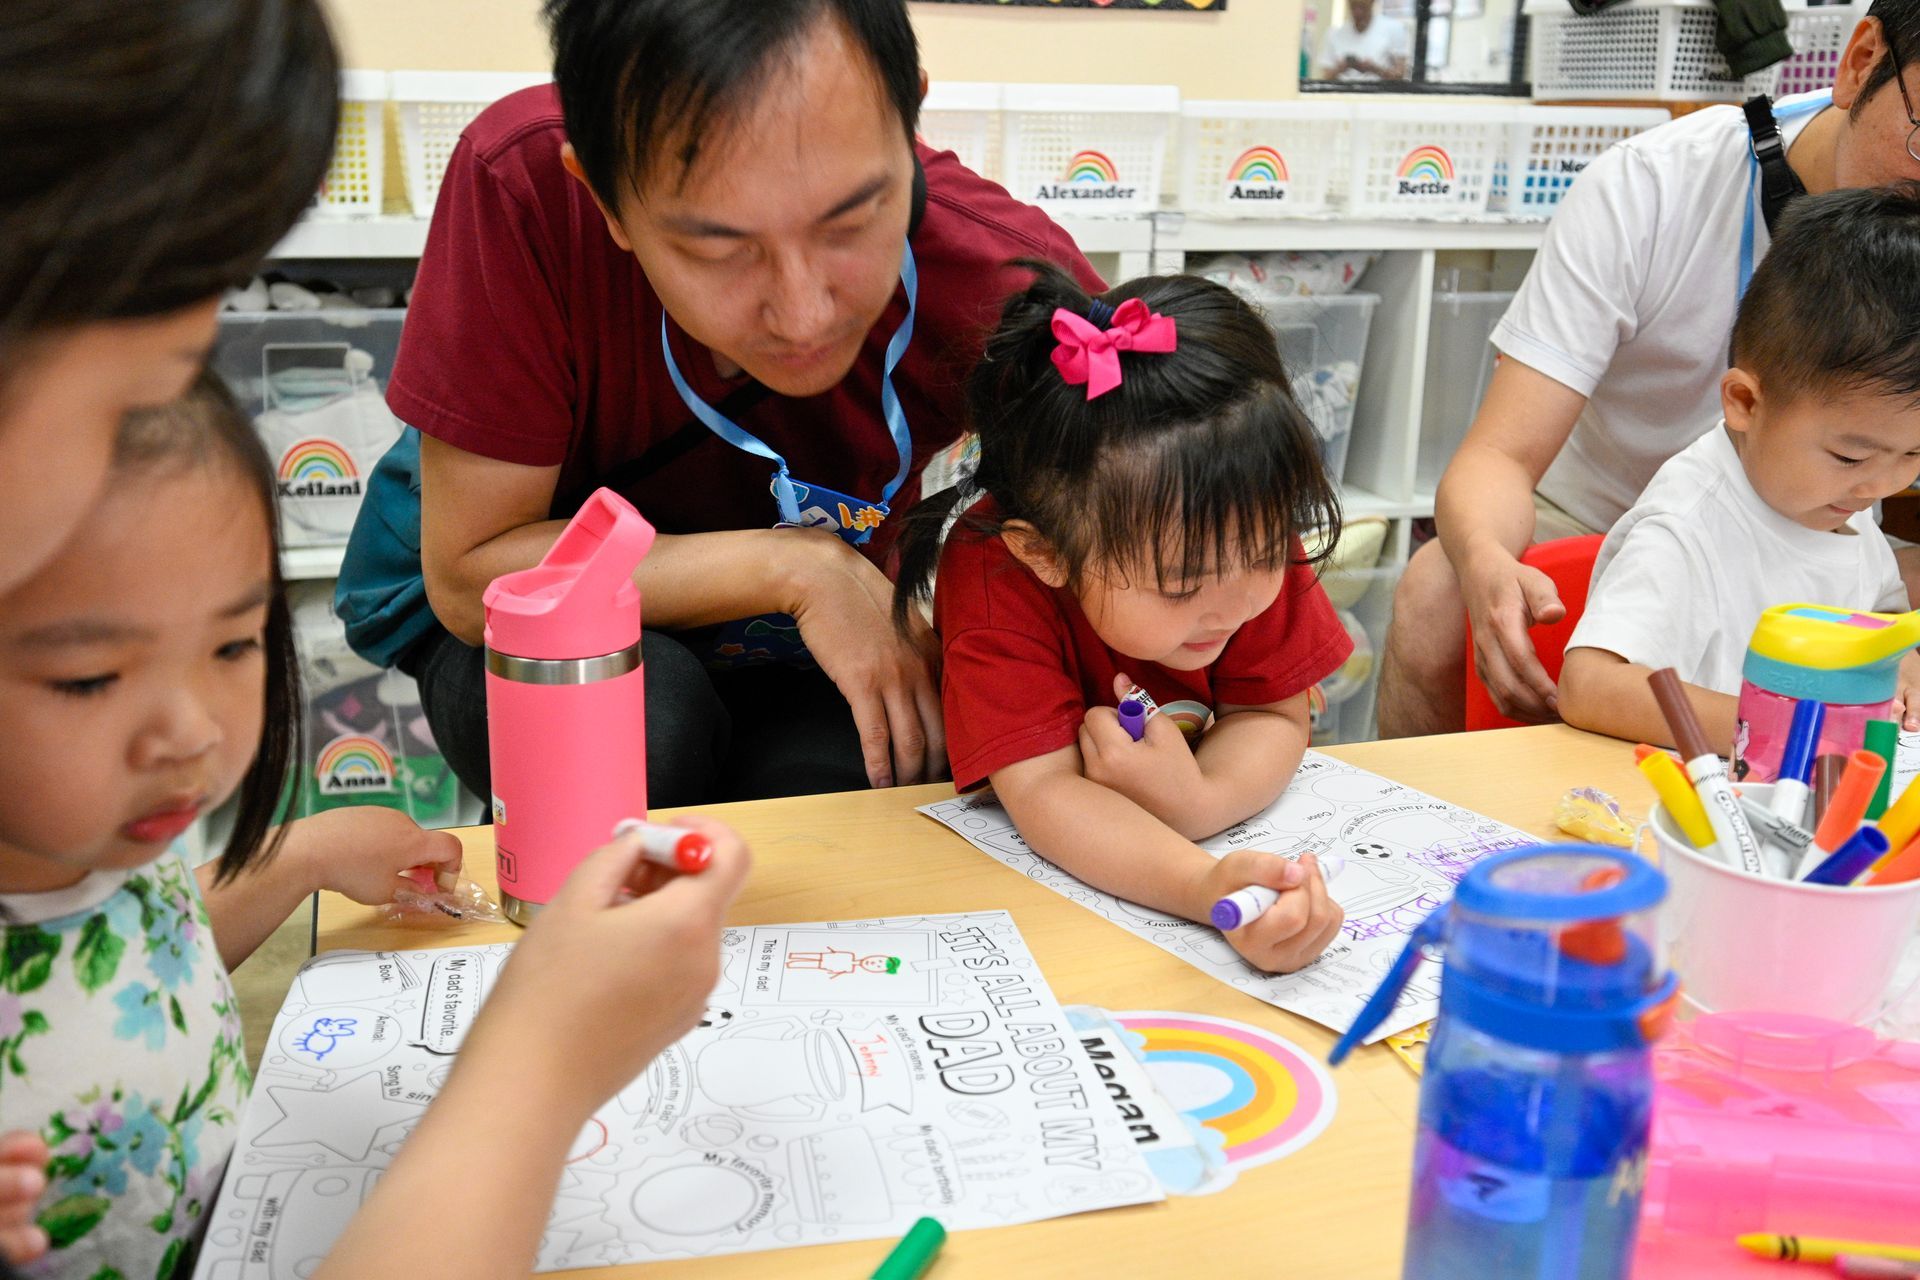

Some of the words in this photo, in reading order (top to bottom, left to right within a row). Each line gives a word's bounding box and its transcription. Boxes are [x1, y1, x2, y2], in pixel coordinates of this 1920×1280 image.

[1036, 184, 1135, 200] Alexander
[1229, 185, 1285, 200] Annie
[1397, 181, 1450, 195] Bettie
[326, 773, 387, 788] Anna
[762, 939, 777, 954] This
[939, 926, 1009, 971] IT'S
[444, 958, 468, 972] My
[756, 961, 770, 972] my
[444, 974, 465, 999] dad's
[974, 974, 1041, 1018] ALL
[885, 1014, 900, 1026] My
[908, 1049, 925, 1072] name
[918, 1010, 1015, 1096] DAD
[383, 1064, 402, 1087] Song
[1004, 1023, 1089, 1110] ABOUT
[388, 1086, 402, 1097] to
[405, 1091, 435, 1102] sin
[1040, 1117, 1101, 1171] MY
[703, 1152, 728, 1167] My
[729, 1155, 773, 1192] favorite
[262, 1197, 281, 1220] with
[251, 1221, 272, 1239] my
